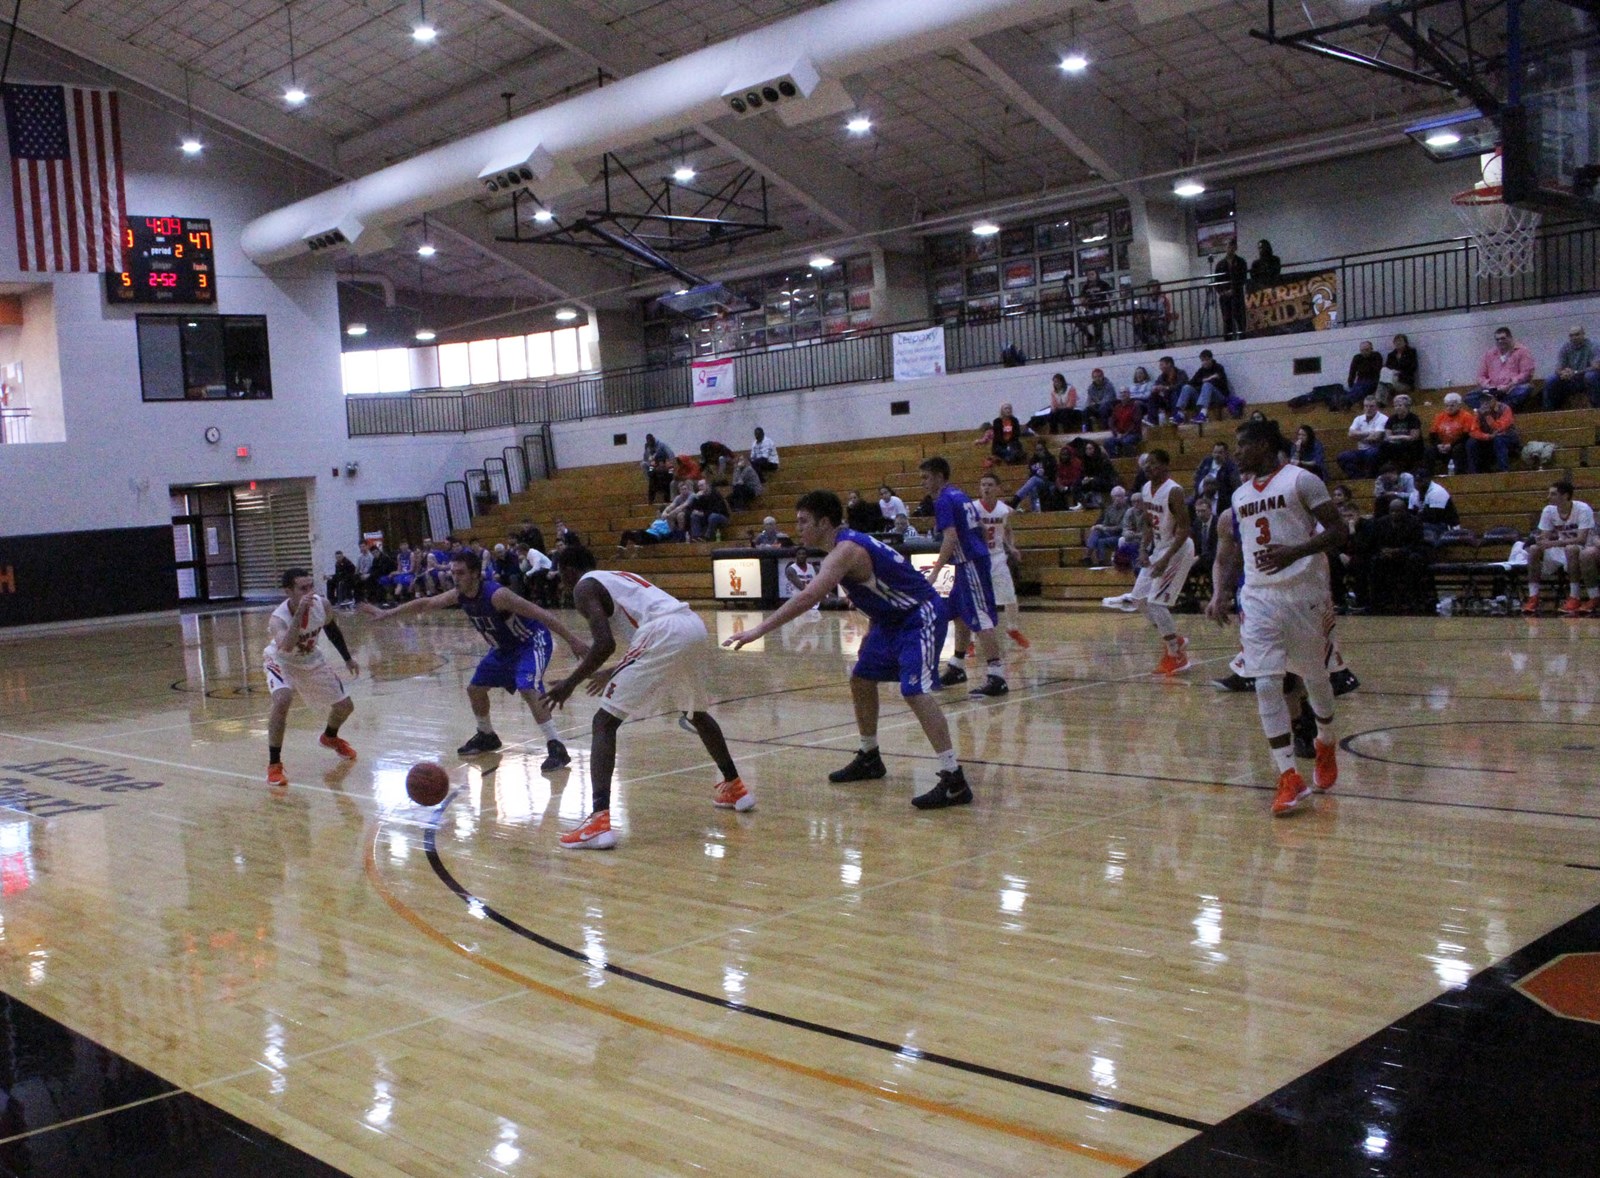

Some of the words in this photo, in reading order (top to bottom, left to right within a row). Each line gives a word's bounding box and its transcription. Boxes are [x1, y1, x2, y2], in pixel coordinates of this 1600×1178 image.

[189, 232, 211, 249] 47
[150, 247, 172, 256] period
[175, 244, 183, 258] 2
[121, 272, 132, 287] 5
[198, 273, 208, 288] 3
[1239, 494, 1287, 519] INDIANA
[1255, 517, 1271, 546] 3
